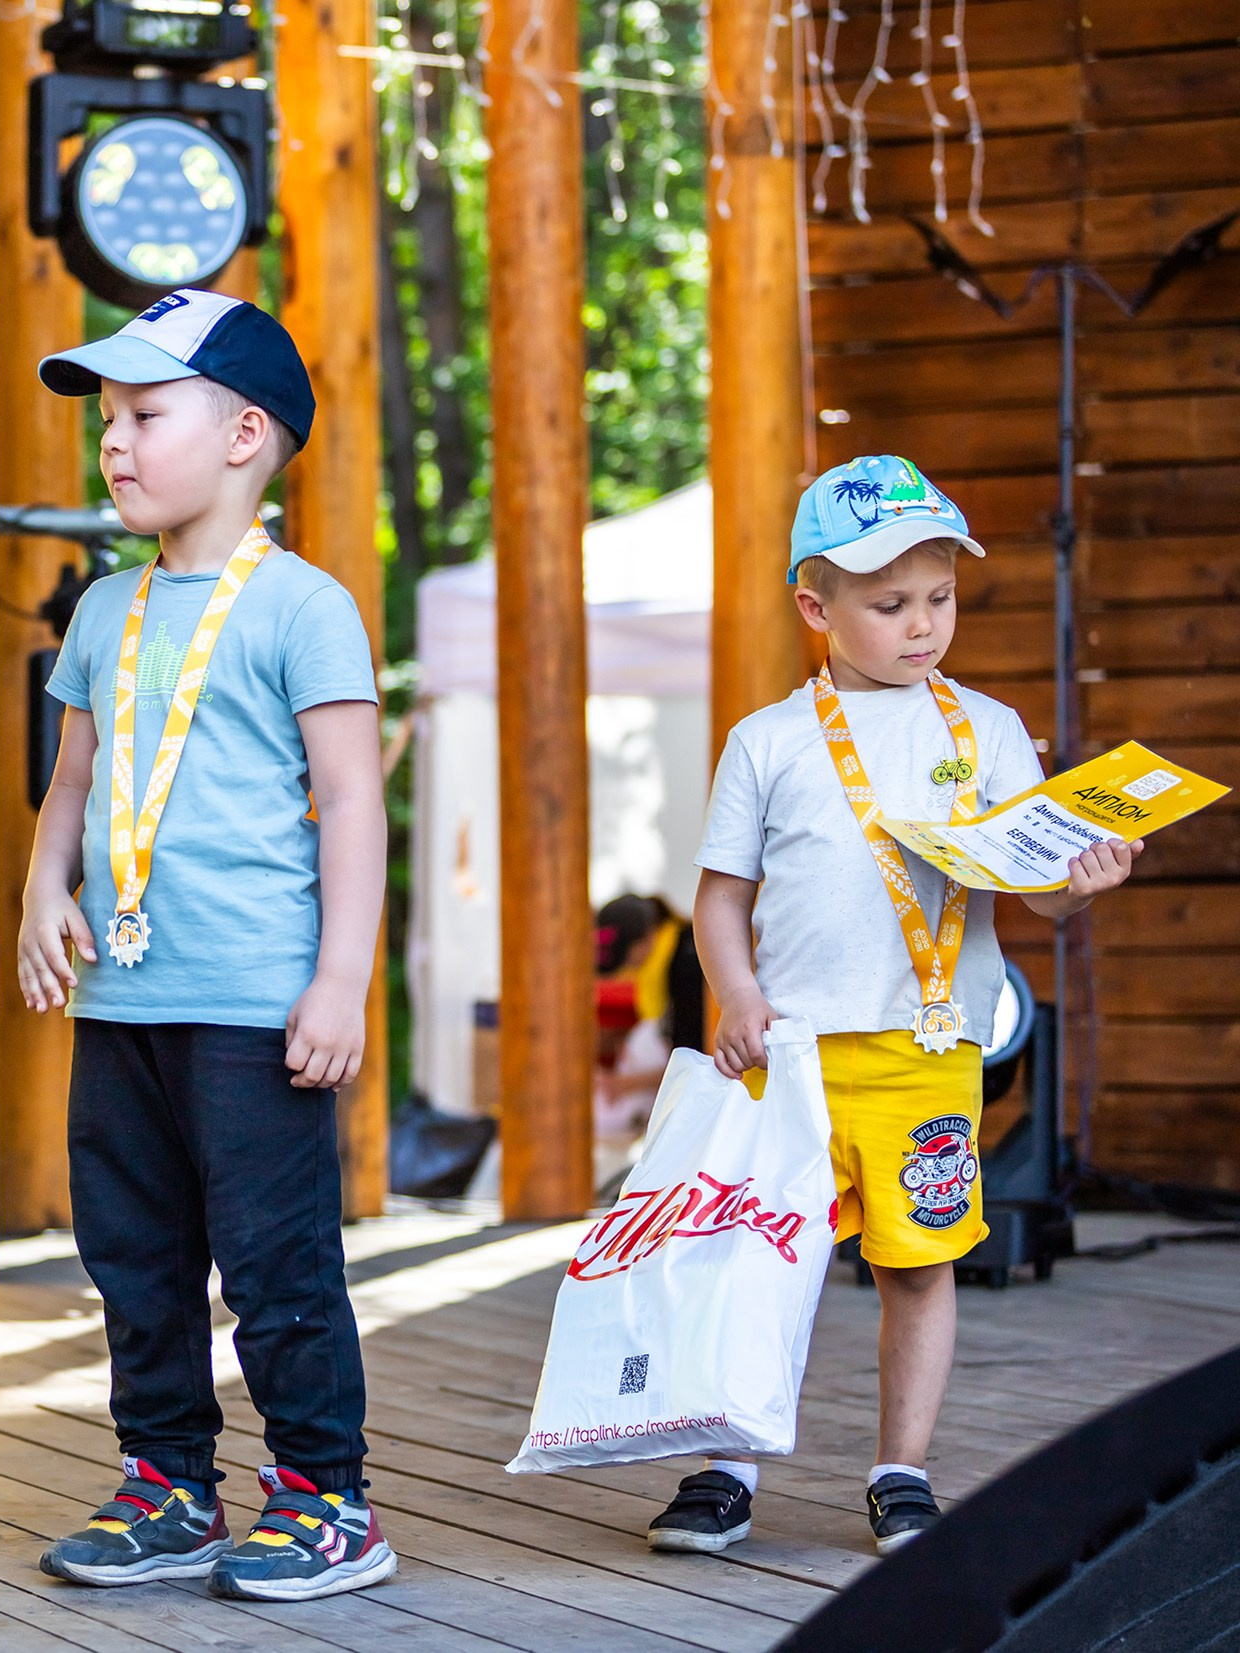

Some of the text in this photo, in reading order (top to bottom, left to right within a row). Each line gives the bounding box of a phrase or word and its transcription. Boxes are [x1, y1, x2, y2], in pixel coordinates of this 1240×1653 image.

[1030, 803, 1074, 832] Дмитрий
[1072, 786, 1152, 823] ДИПЛОМ
[1006, 827, 1062, 863] БЕГОВЕЛИКИ
[916, 1202, 967, 1226] MOTORCYCLE
